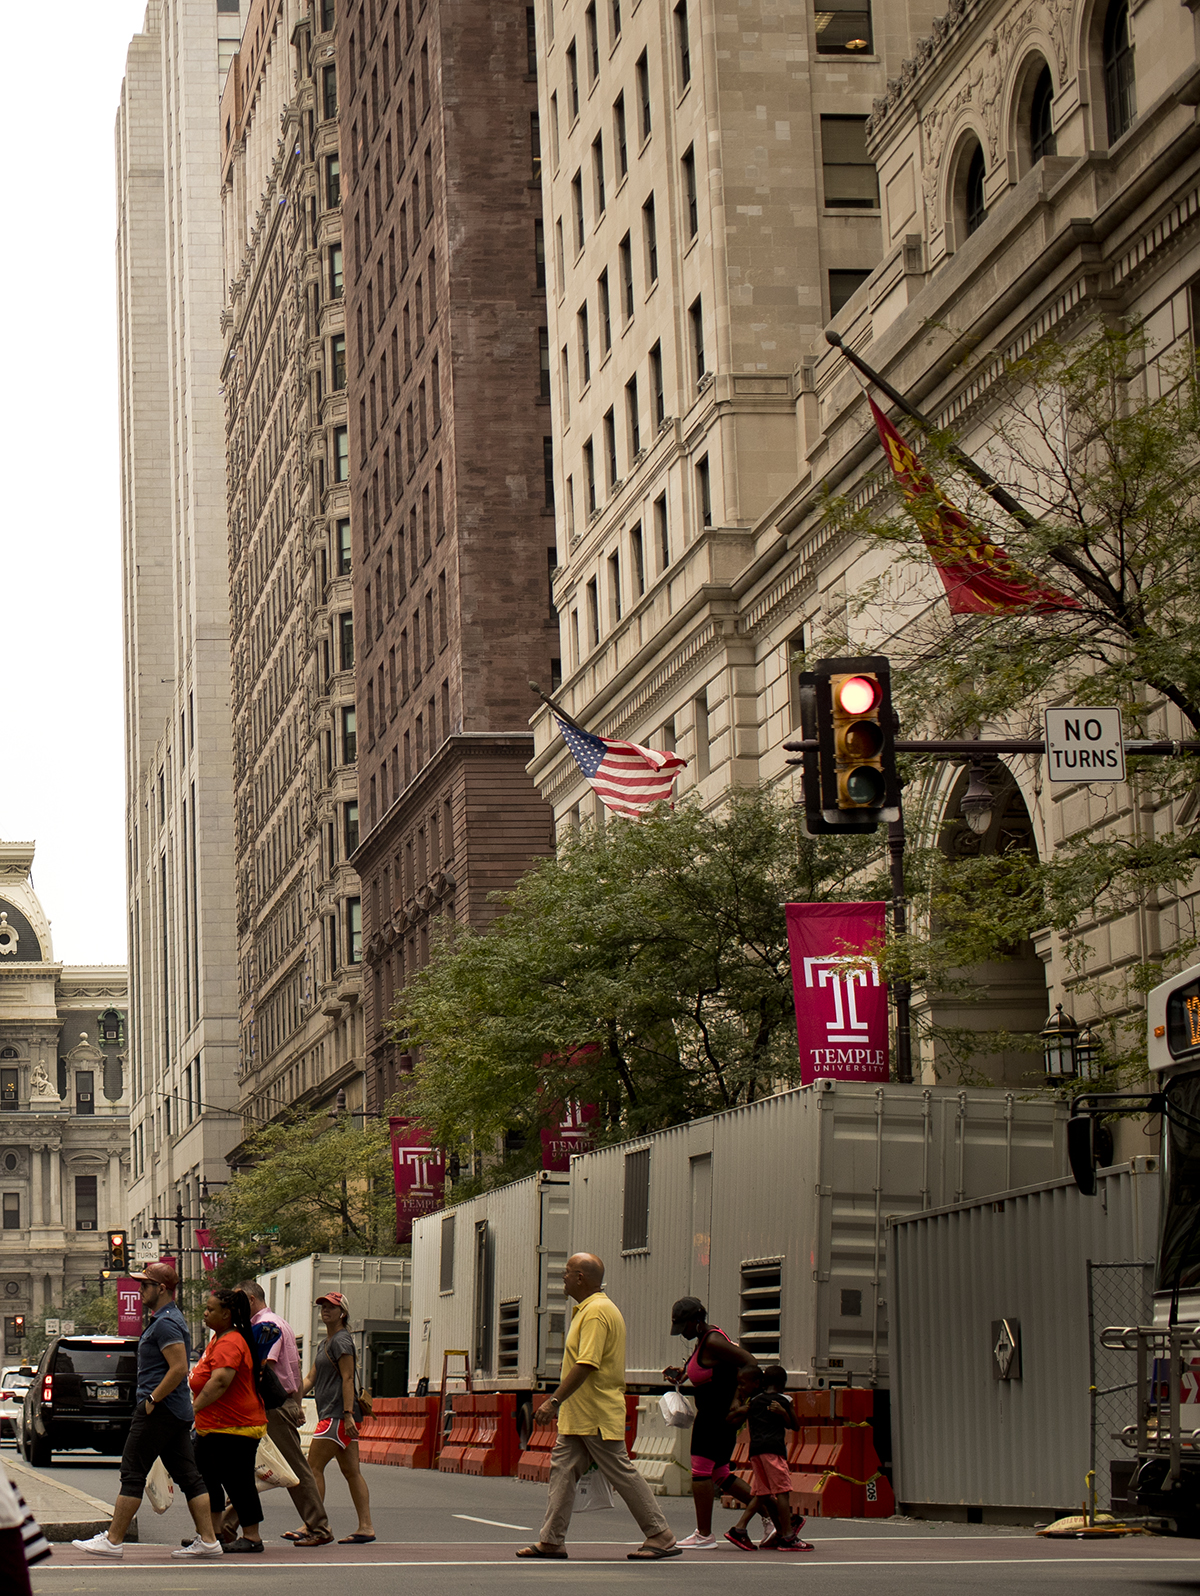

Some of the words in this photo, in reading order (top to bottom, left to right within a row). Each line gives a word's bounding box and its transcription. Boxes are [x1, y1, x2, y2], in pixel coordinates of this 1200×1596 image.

[1064, 718, 1102, 741] NO
[1052, 749, 1118, 768] TURNS
[810, 1048, 885, 1066] TEMPLE
[813, 1064, 884, 1073] UNIVERSITY
[141, 1241, 153, 1250] NO
